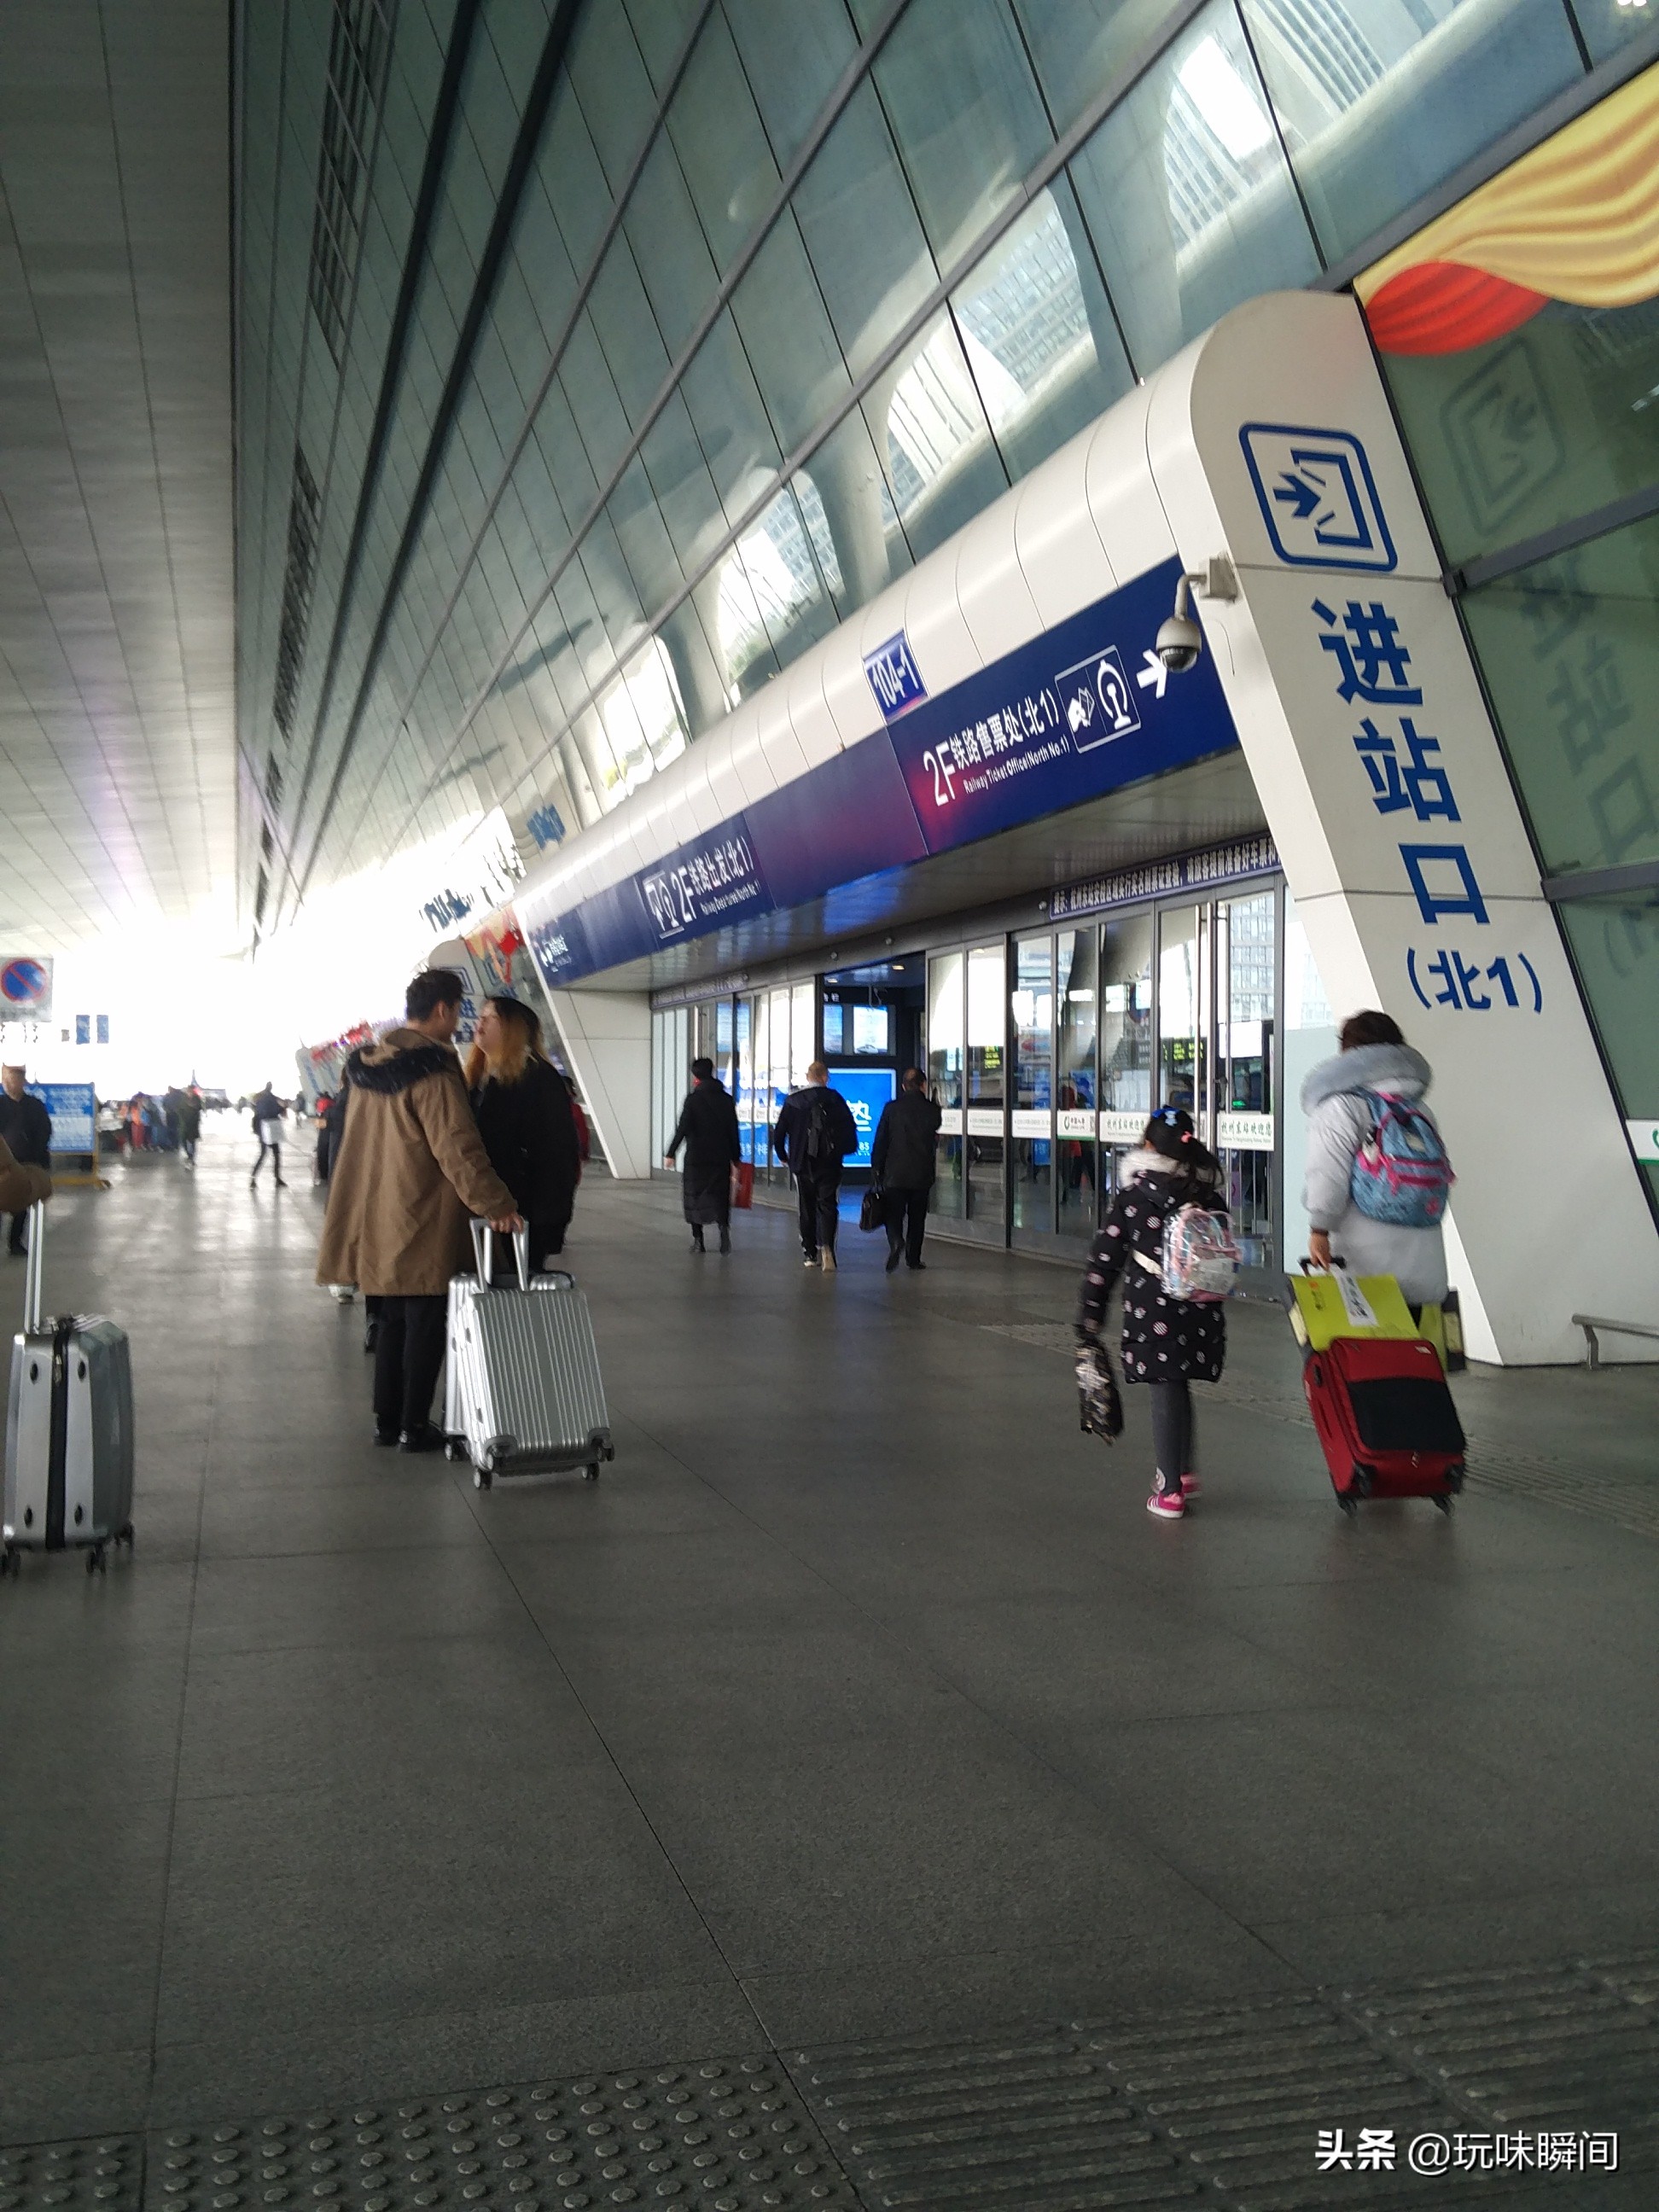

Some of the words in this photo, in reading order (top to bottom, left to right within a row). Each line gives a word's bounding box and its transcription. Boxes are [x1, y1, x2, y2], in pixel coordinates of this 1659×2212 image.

[871, 643, 920, 708] 104-1
[963, 774, 988, 794] Railway
[986, 767, 1009, 784] Ticket
[1311, 598, 1490, 925] 进站口
[1407, 947, 1542, 1014] (北1)
